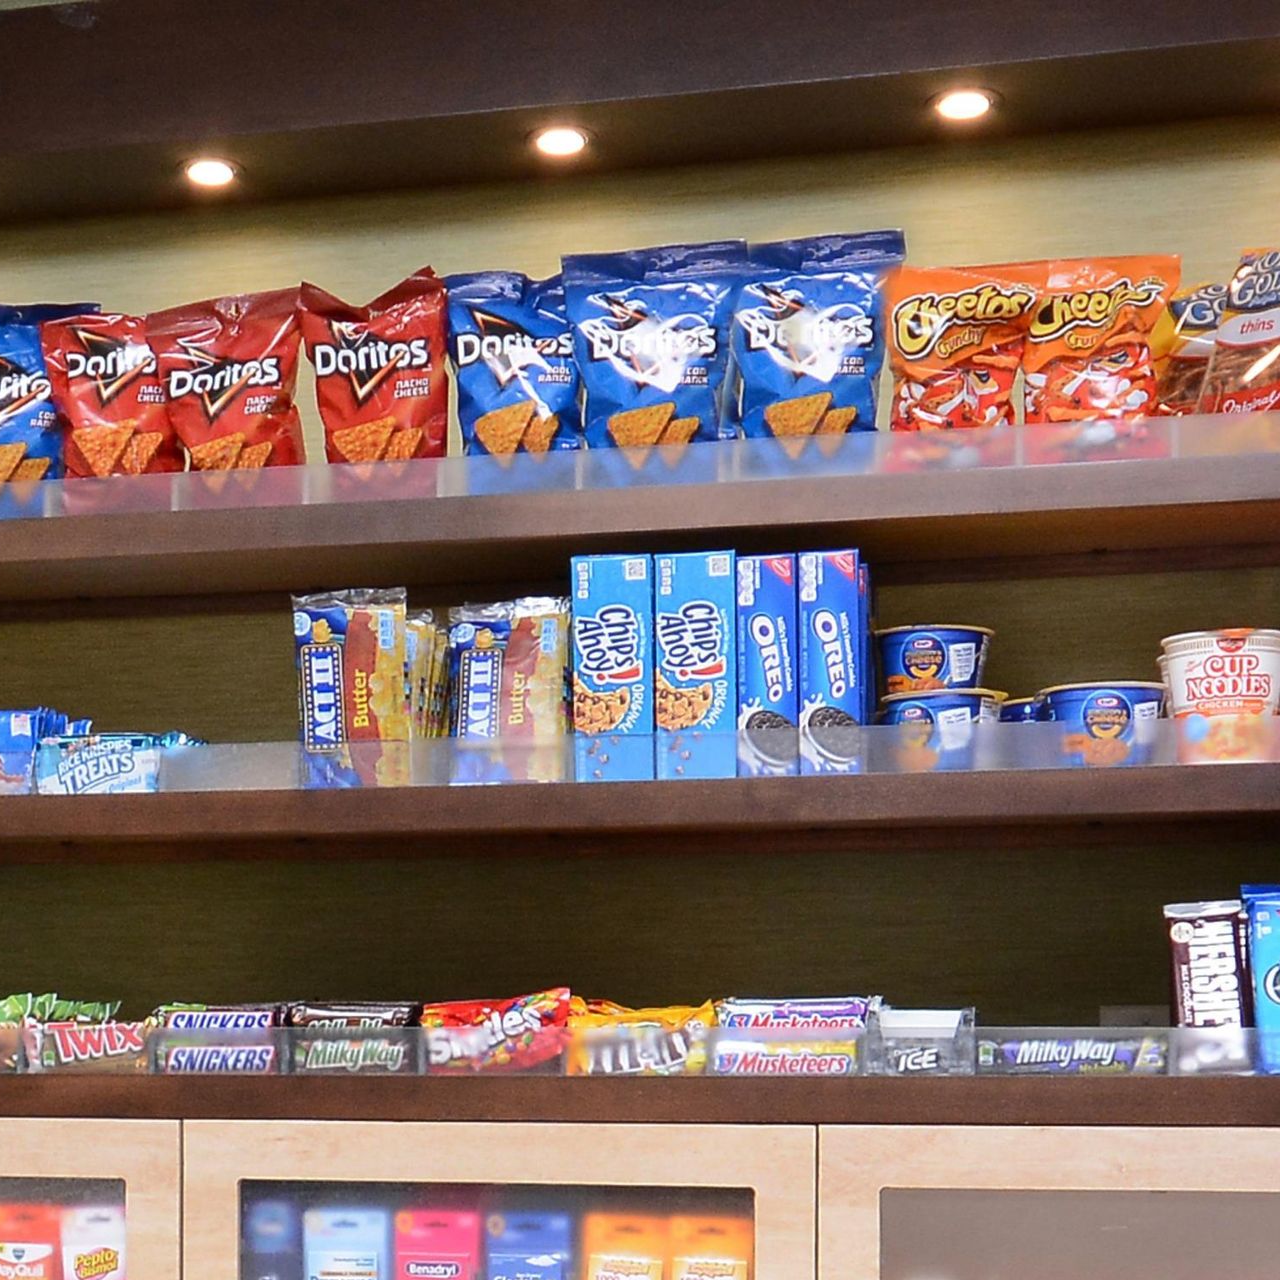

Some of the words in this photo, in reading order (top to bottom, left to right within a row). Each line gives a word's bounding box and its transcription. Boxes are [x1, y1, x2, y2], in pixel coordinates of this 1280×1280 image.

[1190, 284, 1227, 300] RO
[896, 284, 1031, 354] Cheetos
[1185, 298, 1227, 325] GO
[934, 325, 986, 357] Crunchy
[1065, 329, 1101, 349] Crun
[1239, 318, 1275, 335] thins
[66, 347, 156, 378] Dorito
[315, 339, 429, 376] Doritos
[456, 333, 573, 365] Doritos
[139, 384, 164, 393] NAC
[170, 357, 279, 398] Doritos
[393, 386, 430, 398] CHEESE
[395, 377, 428, 388] NACHO
[537, 373, 572, 384] RANCH
[136, 393, 166, 403] CHEES
[38, 410, 56, 419] COO
[599, 607, 637, 667] Chips
[660, 614, 725, 678] Ahoy!
[682, 603, 721, 664] Chips
[577, 617, 641, 681] Ahoy!
[750, 613, 783, 702] OREO
[813, 609, 847, 699] OREO
[1204, 654, 1260, 678] CUP
[353, 668, 370, 728] Butter
[508, 671, 525, 725] Butter
[1186, 674, 1271, 701] NOODLES
[313, 687, 338, 742] ACT
[468, 686, 492, 738] ACT
[1198, 700, 1244, 711] CHICKEN
[57, 751, 81, 776] RICE
[81, 738, 134, 762] KRISPIES
[60, 752, 134, 793] TREATS
[170, 1046, 271, 1073] SNICKERS
[306, 1039, 361, 1071] Milky
[356, 1040, 404, 1071] Way
[720, 1055, 736, 1073] 3
[736, 1053, 849, 1074] Musketeers
[897, 1048, 939, 1072] ICE
[1017, 1039, 1070, 1065] Milky
[1069, 1039, 1117, 1066] Way
[80, 1260, 118, 1279] Bismol
[409, 1263, 457, 1278] Benadryl
